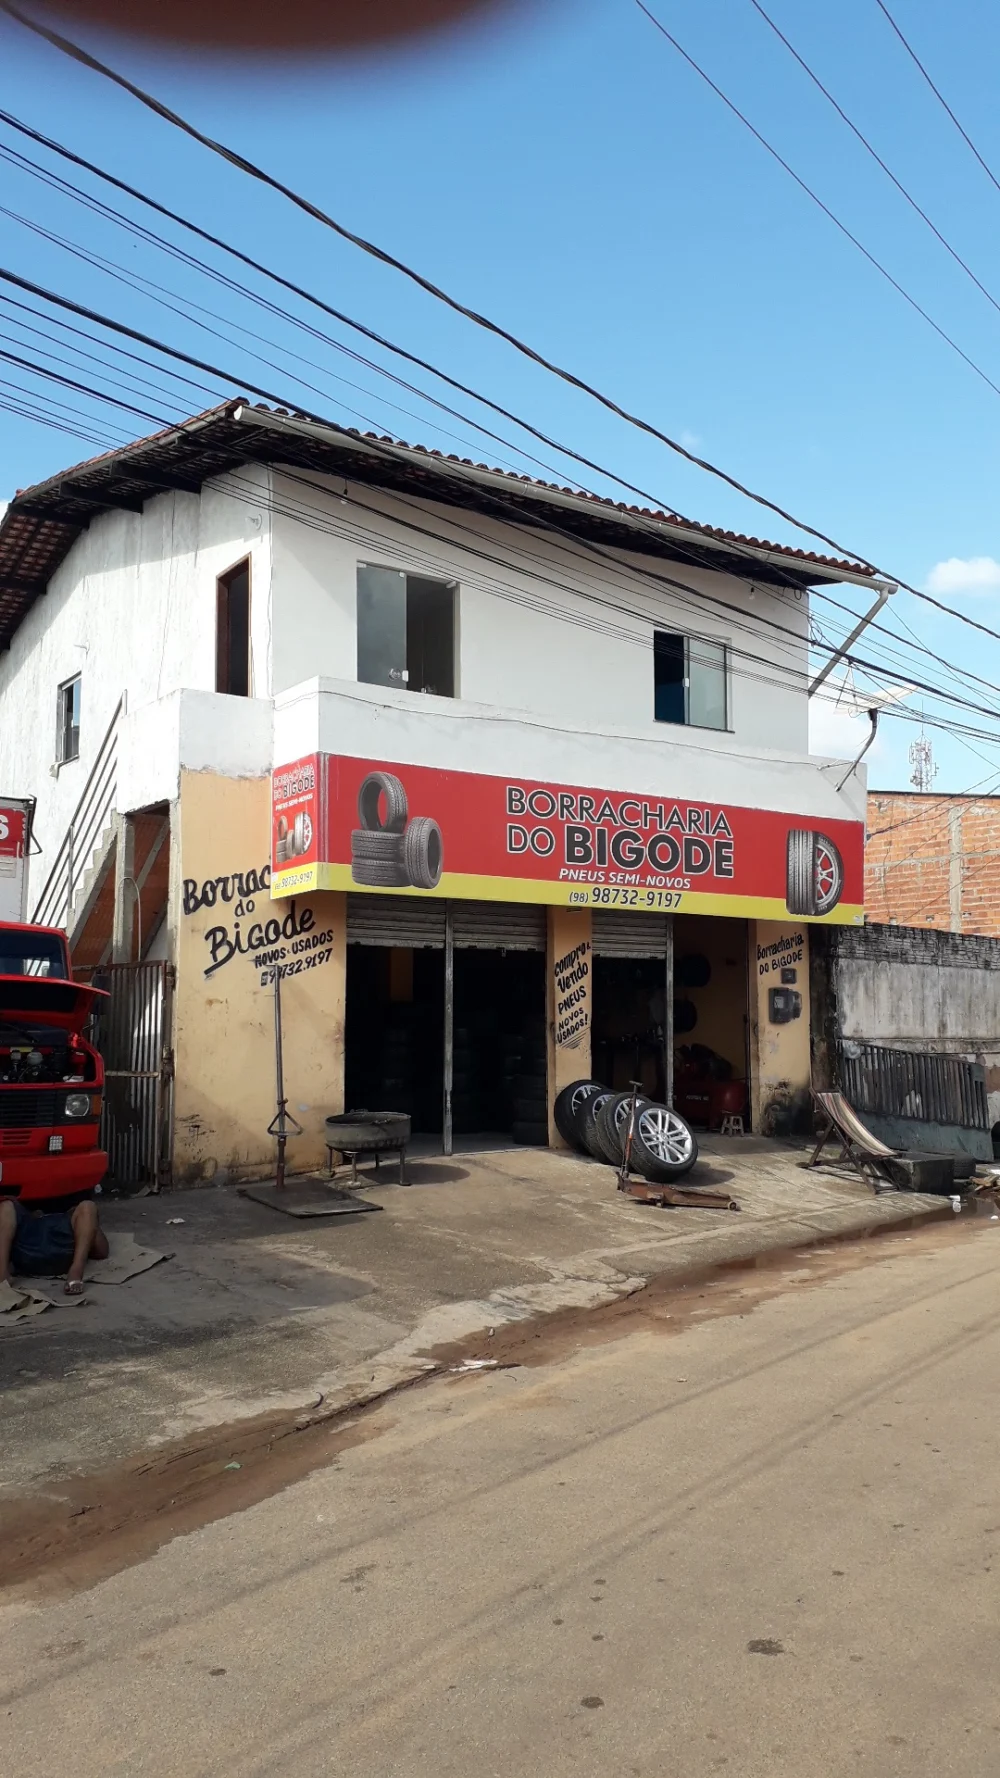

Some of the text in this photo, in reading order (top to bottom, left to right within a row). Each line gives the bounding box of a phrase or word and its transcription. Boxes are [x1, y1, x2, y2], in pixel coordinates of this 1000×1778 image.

[283, 775, 315, 798] BIGODE
[506, 785, 734, 838] BORRACHARIA
[507, 823, 734, 878] DO BIGODE
[559, 868, 691, 889] PNEUS SEMI-NOVOS
[234, 899, 255, 917] do
[569, 887, 683, 908] (98) 98732-9197
[255, 947, 286, 969] NOVOS
[292, 929, 334, 955] USADOS
[760, 949, 803, 975] DO BIGODE
[558, 985, 587, 1015] PNEUS
[556, 1013, 588, 1044] USADOS!
[558, 1007, 584, 1031] NOVOS
